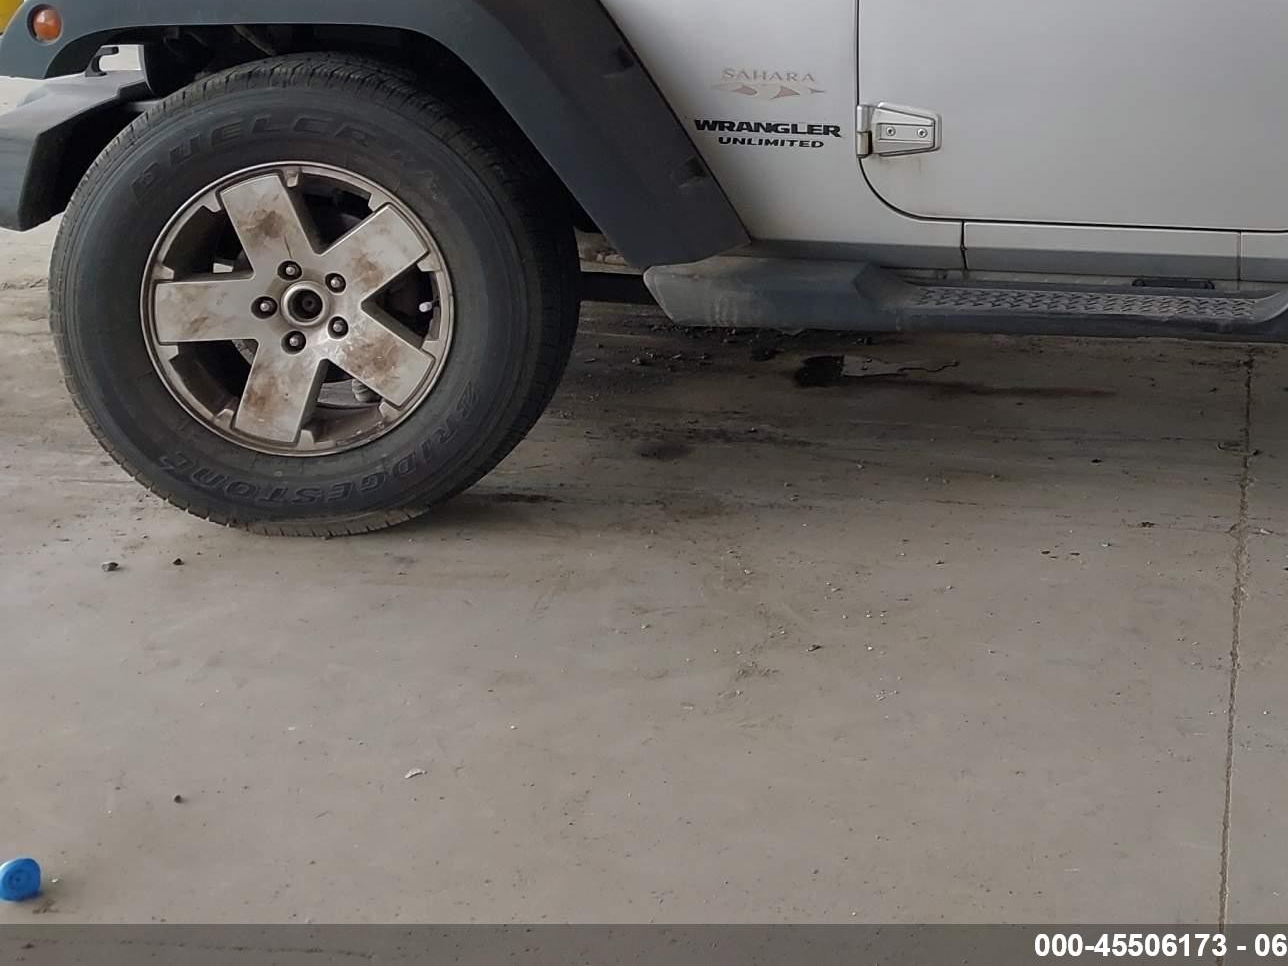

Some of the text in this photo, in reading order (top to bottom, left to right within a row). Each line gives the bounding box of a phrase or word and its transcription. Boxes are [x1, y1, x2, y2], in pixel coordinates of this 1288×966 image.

[721, 67, 816, 83] SAHARA
[694, 119, 842, 138] WRANGLER
[718, 136, 825, 149] UNLIMITED
